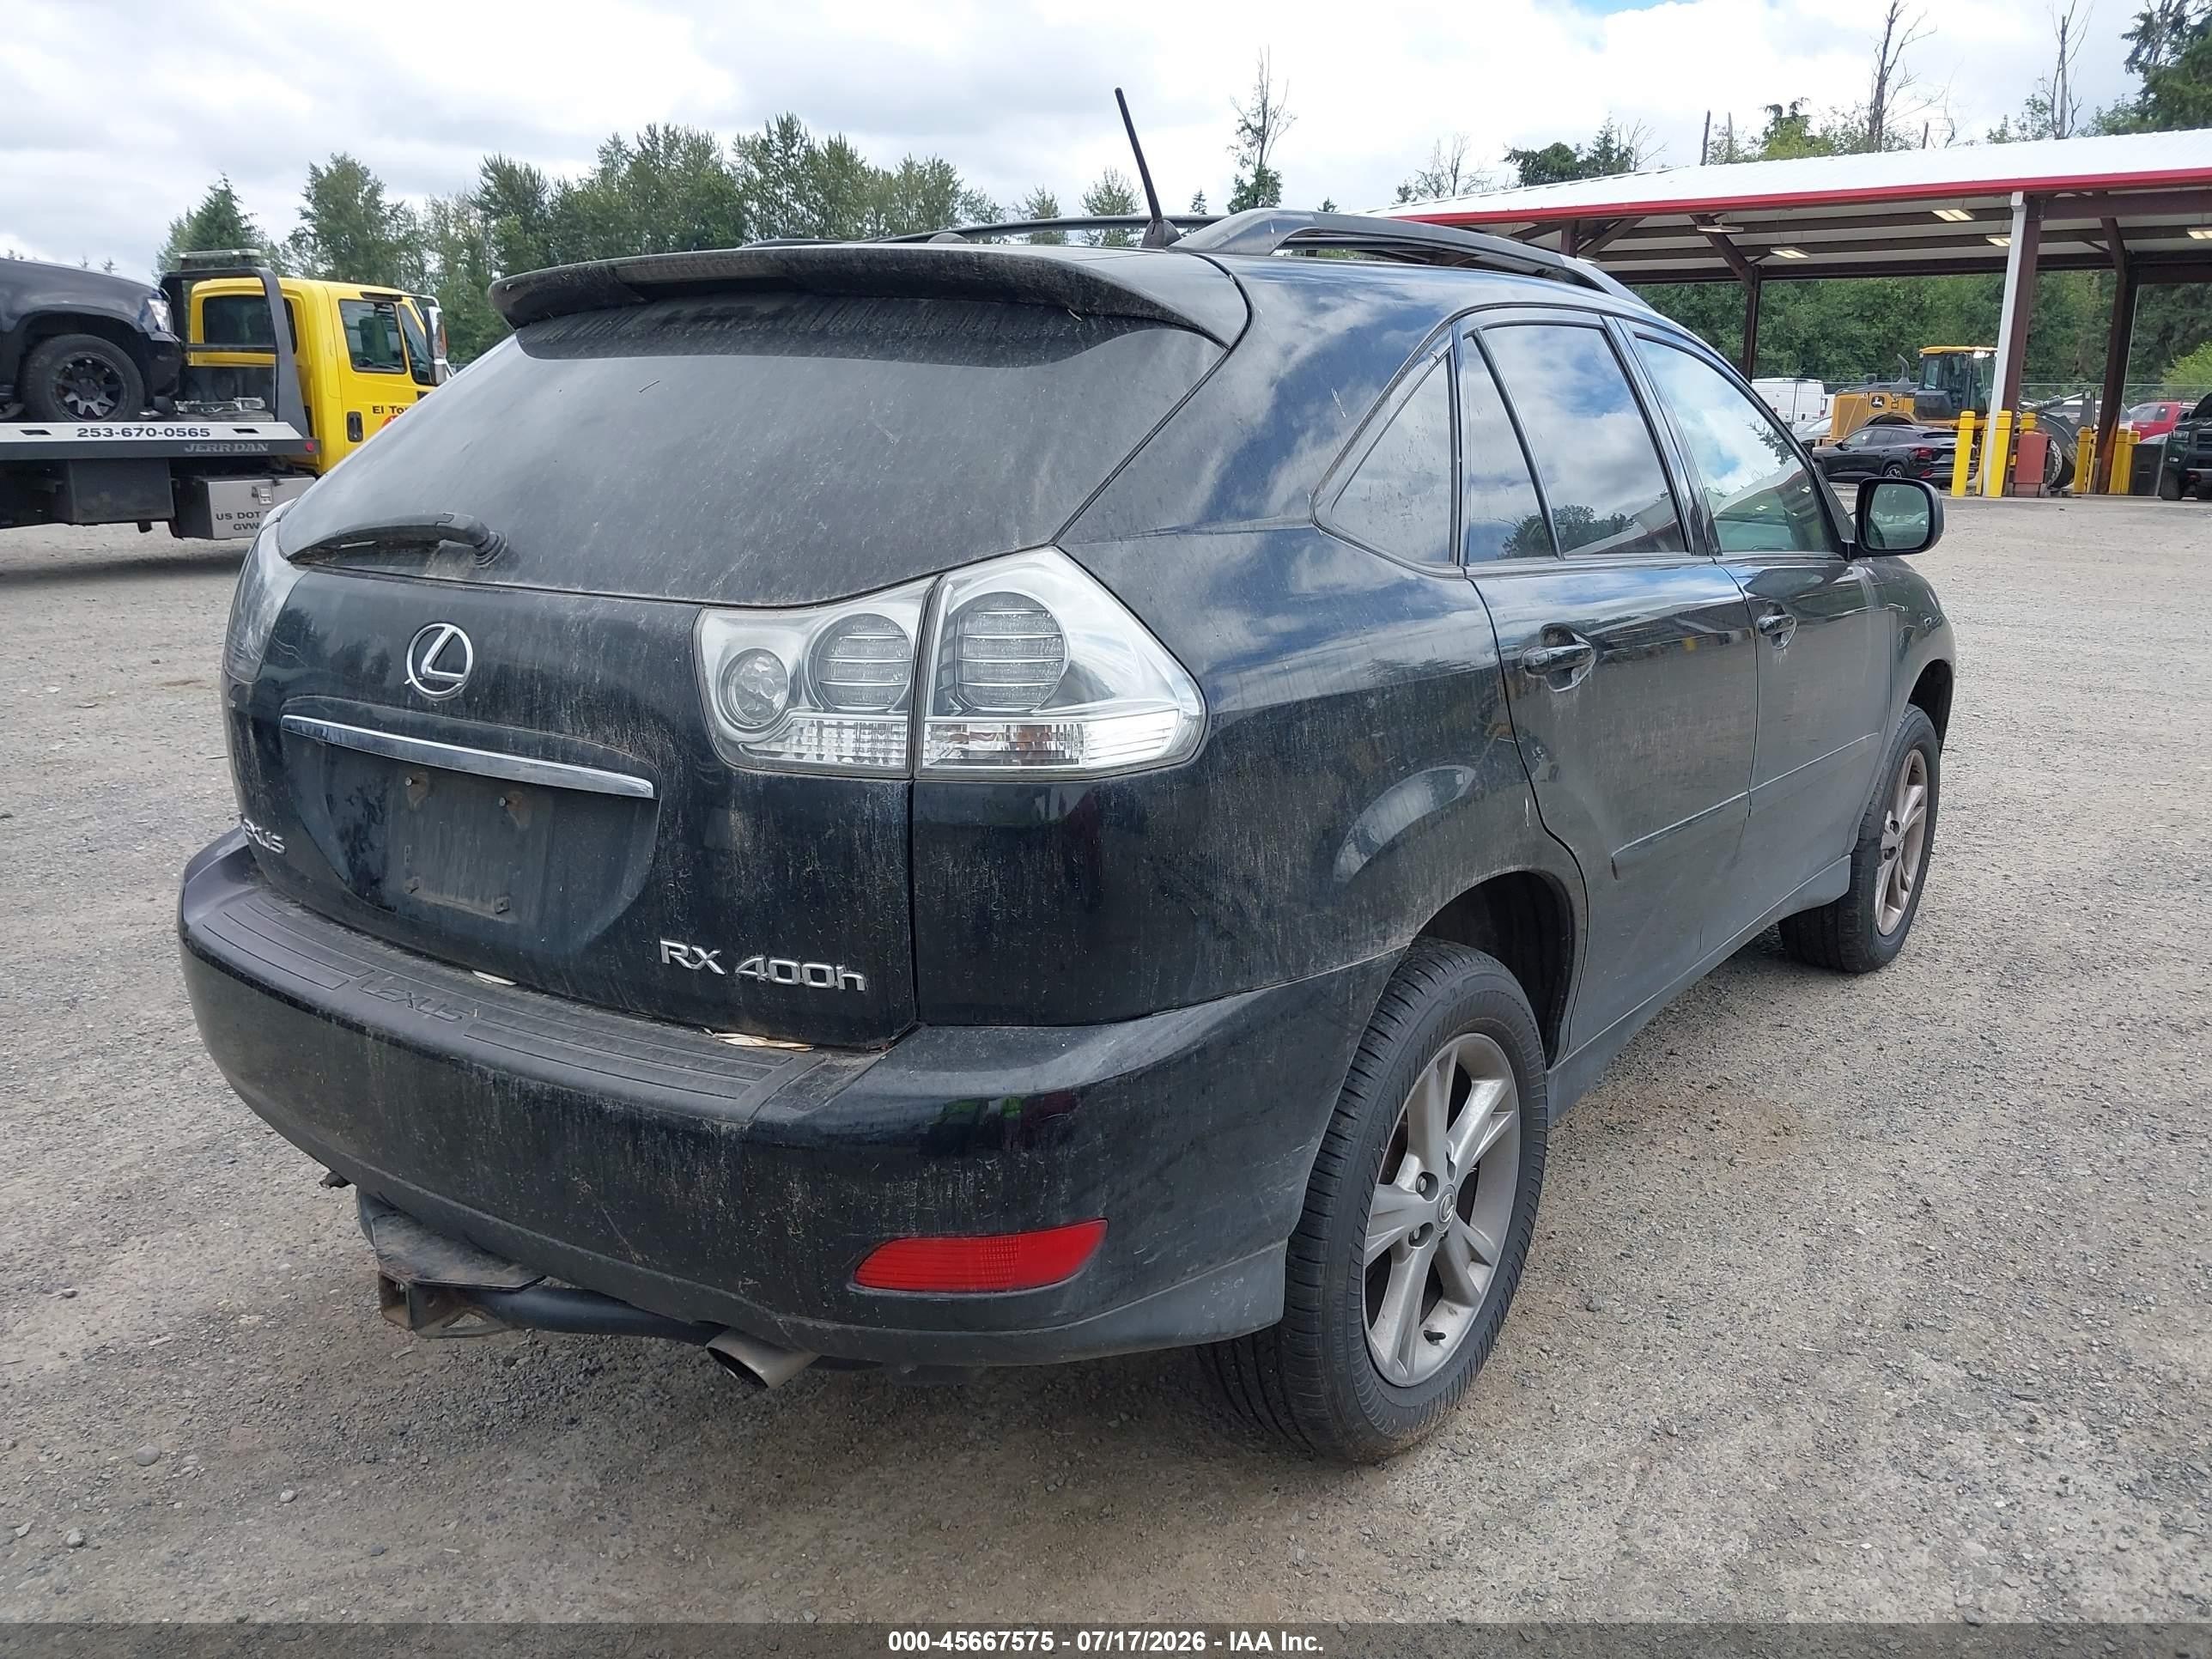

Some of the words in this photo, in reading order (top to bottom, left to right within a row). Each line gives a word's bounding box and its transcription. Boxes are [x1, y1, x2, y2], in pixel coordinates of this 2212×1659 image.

[372, 405, 385, 414] El
[76, 428, 211, 438] 253-670-0565
[237, 511, 261, 520] DOT
[659, 939, 726, 975] RX
[734, 956, 867, 992] 400h
[357, 980, 471, 1024] LEXUS
